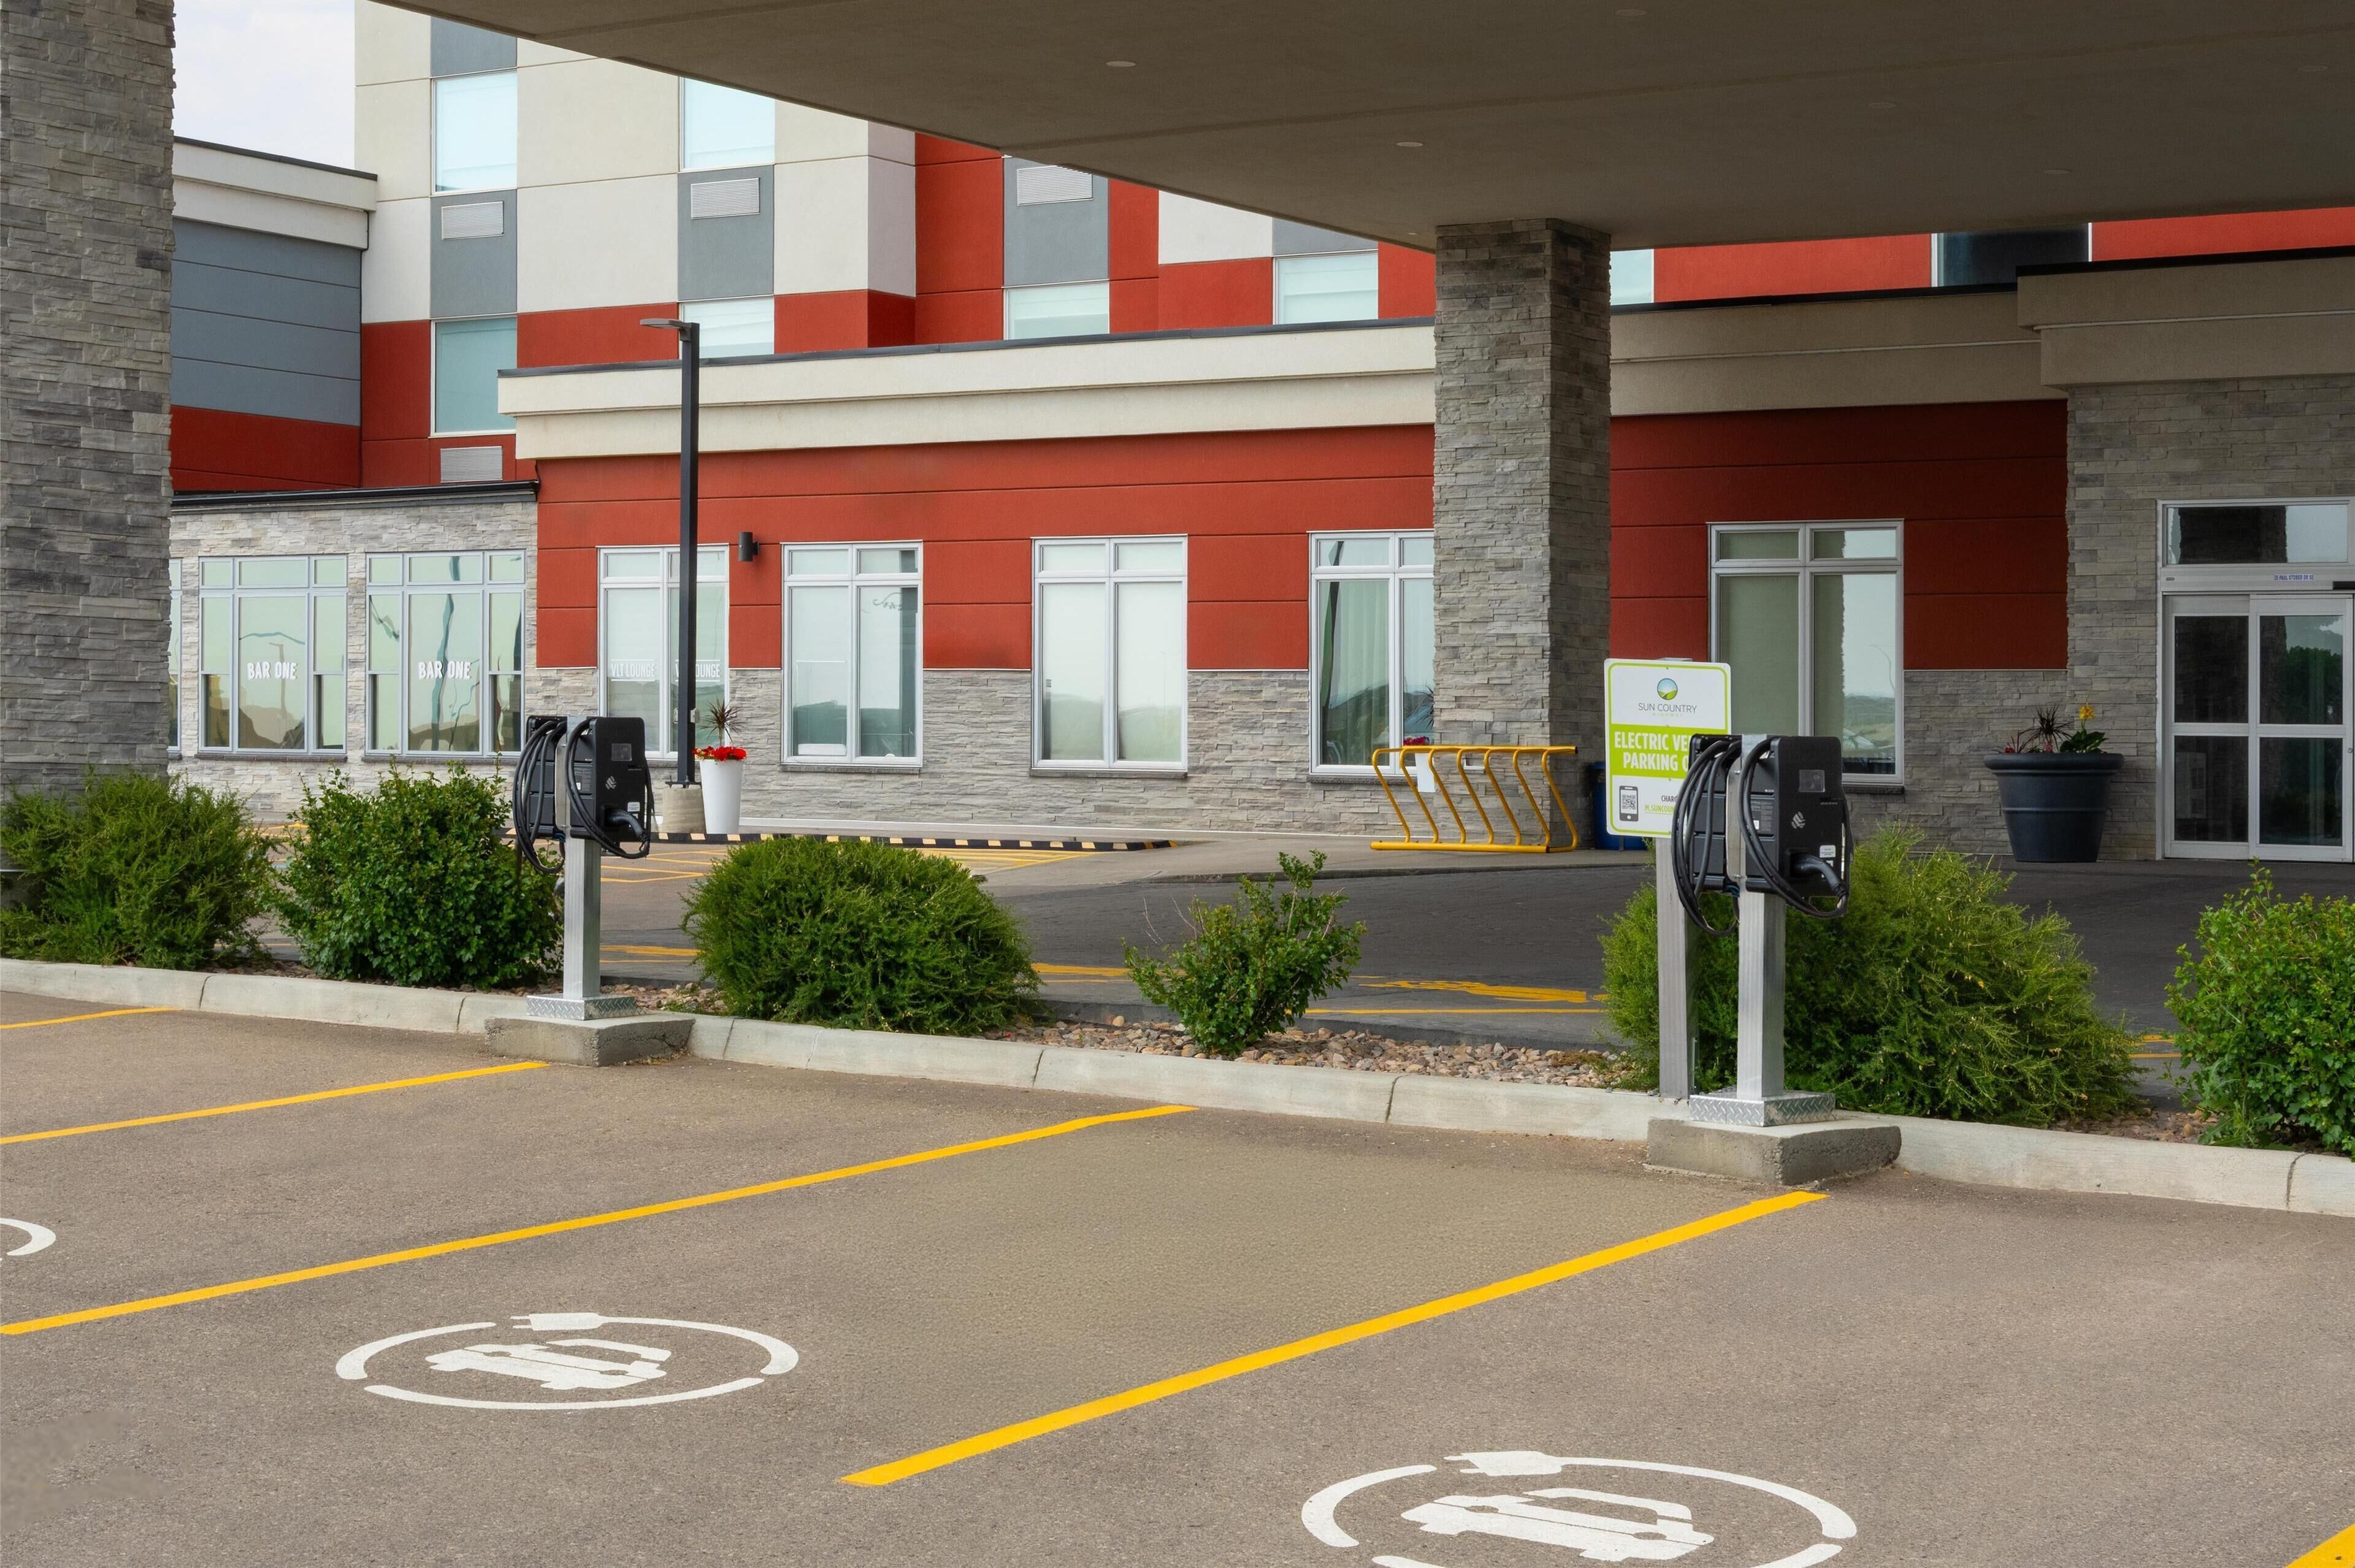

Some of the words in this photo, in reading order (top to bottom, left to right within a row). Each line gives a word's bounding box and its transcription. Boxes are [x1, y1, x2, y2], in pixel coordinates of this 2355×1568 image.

[247, 662, 270, 679] BAR
[275, 662, 297, 679] ONE
[418, 661, 443, 679] BAR
[447, 661, 471, 679] ONE
[611, 663, 624, 677] VLT
[626, 663, 656, 678] LOUNGE
[695, 664, 721, 678] OUNGE
[1638, 703, 1655, 711] SUN
[1657, 703, 1698, 713] COUNTRY
[1614, 732, 1669, 751] ELECTRIC
[1672, 734, 1692, 752] VE
[1623, 751, 1679, 771] PARKING
[1645, 804, 1676, 813] M.SUNCOUN
